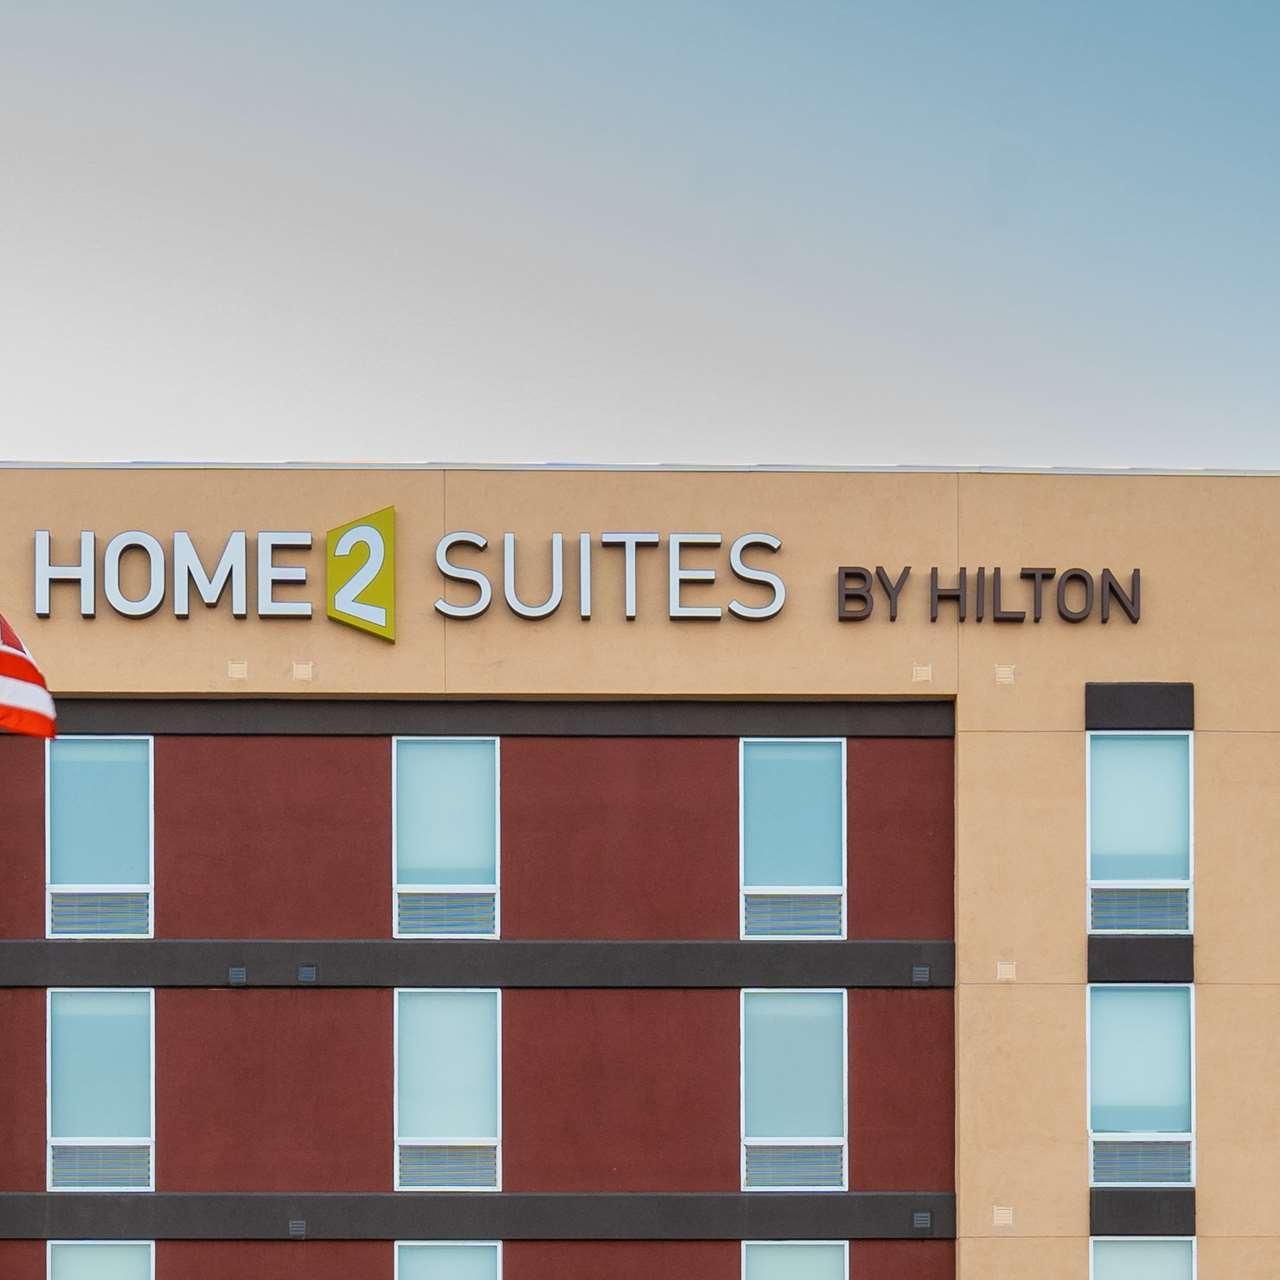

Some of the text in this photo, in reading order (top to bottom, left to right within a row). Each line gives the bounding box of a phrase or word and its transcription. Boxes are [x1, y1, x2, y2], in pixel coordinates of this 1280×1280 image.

[34, 523, 1140, 628] HOME 2 SUITES BY HILTON
